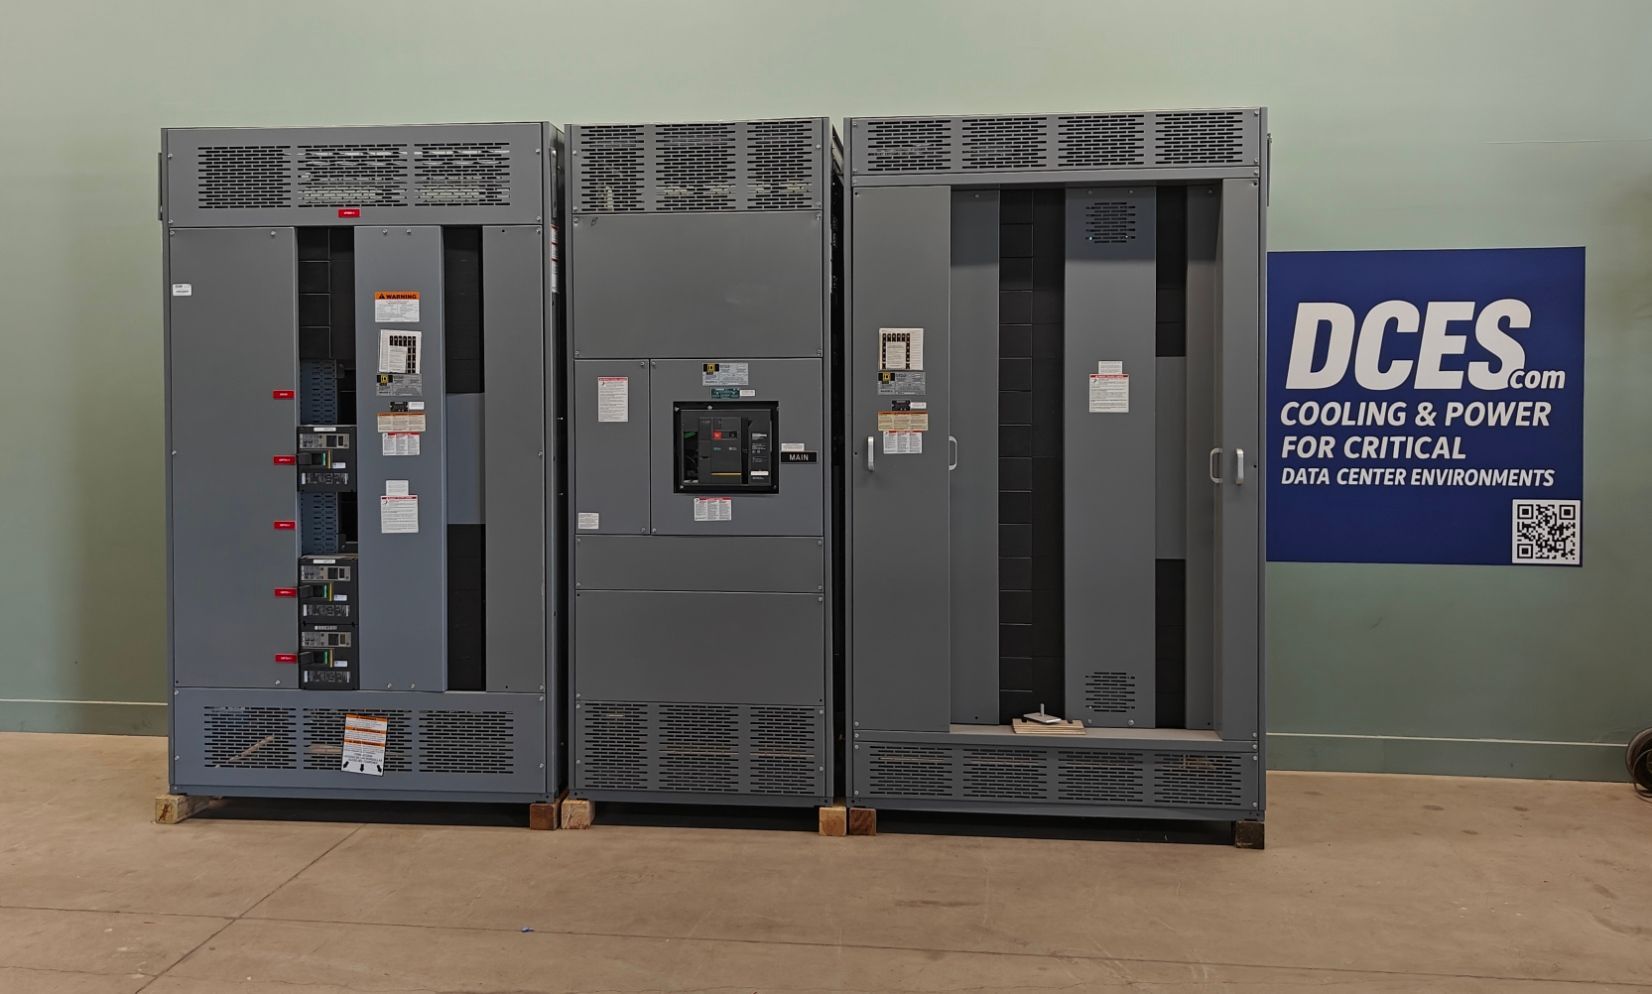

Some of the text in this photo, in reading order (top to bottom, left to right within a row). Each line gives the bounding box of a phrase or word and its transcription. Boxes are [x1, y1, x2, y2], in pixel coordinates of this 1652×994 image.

[1285, 298, 1532, 391] DCES
[1280, 401, 1552, 427] COOLING & POWER
[789, 453, 809, 461] MAIN
[1281, 435, 1466, 460] FOR CRITICAL
[1281, 467, 1556, 487] DATA CENTER ENVIRONMENTS
